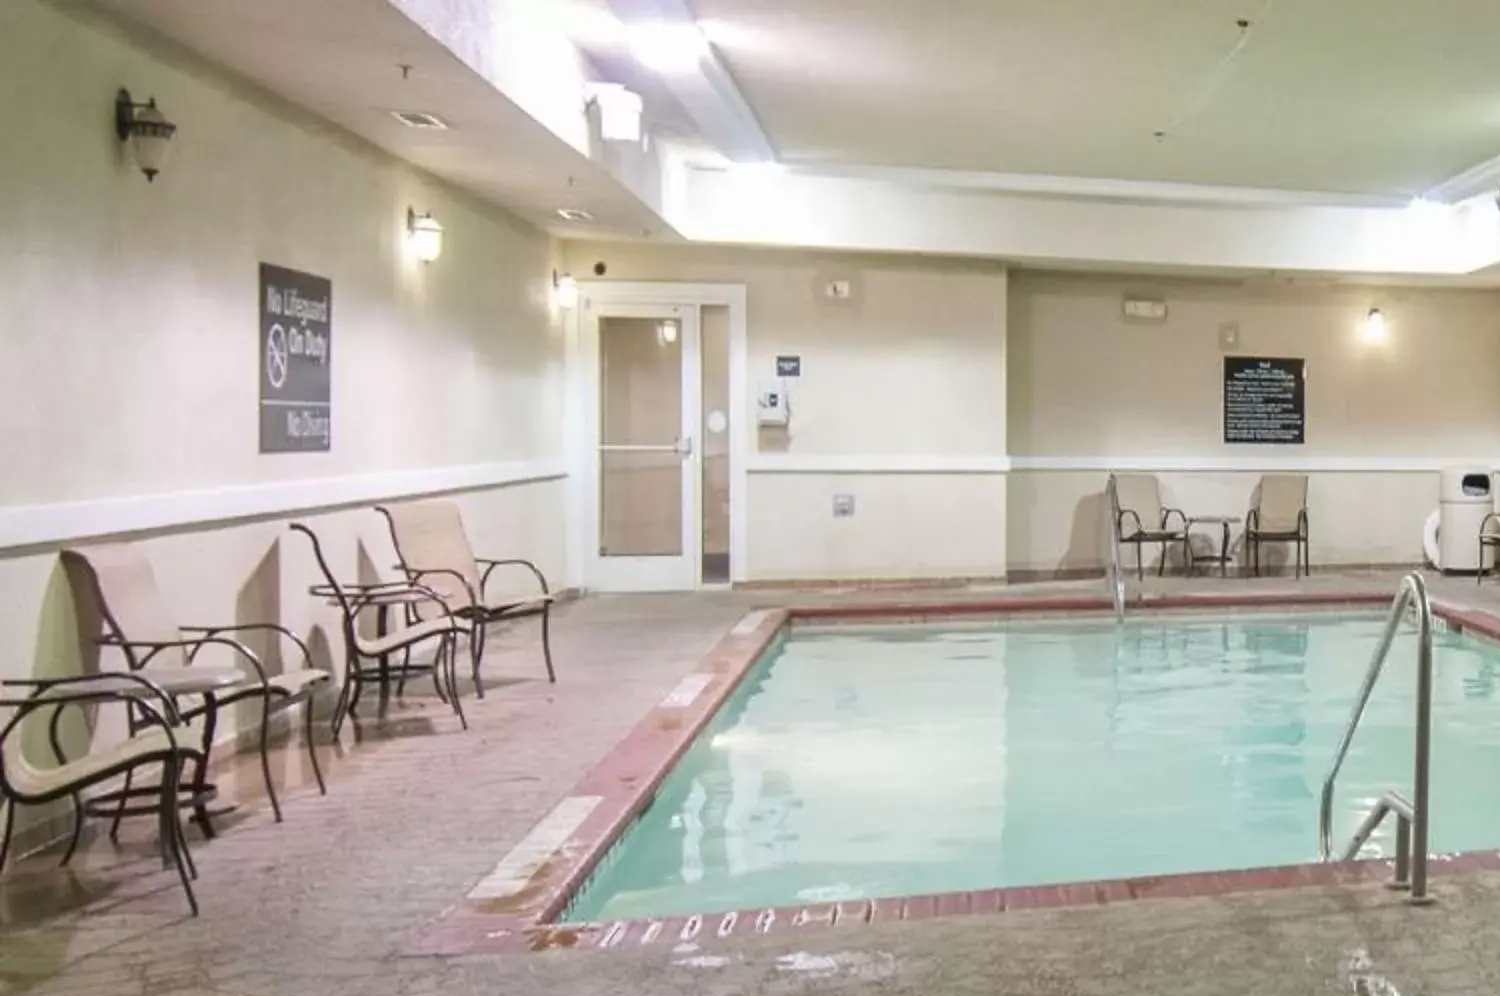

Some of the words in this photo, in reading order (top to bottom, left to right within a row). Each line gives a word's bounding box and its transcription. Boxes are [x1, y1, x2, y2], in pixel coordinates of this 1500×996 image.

[267, 285, 282, 315] No
[283, 289, 328, 327] Lifeguard
[289, 327, 303, 355] On
[305, 329, 327, 365] Duty
[287, 411, 300, 437] No
[302, 408, 329, 446] Diving
